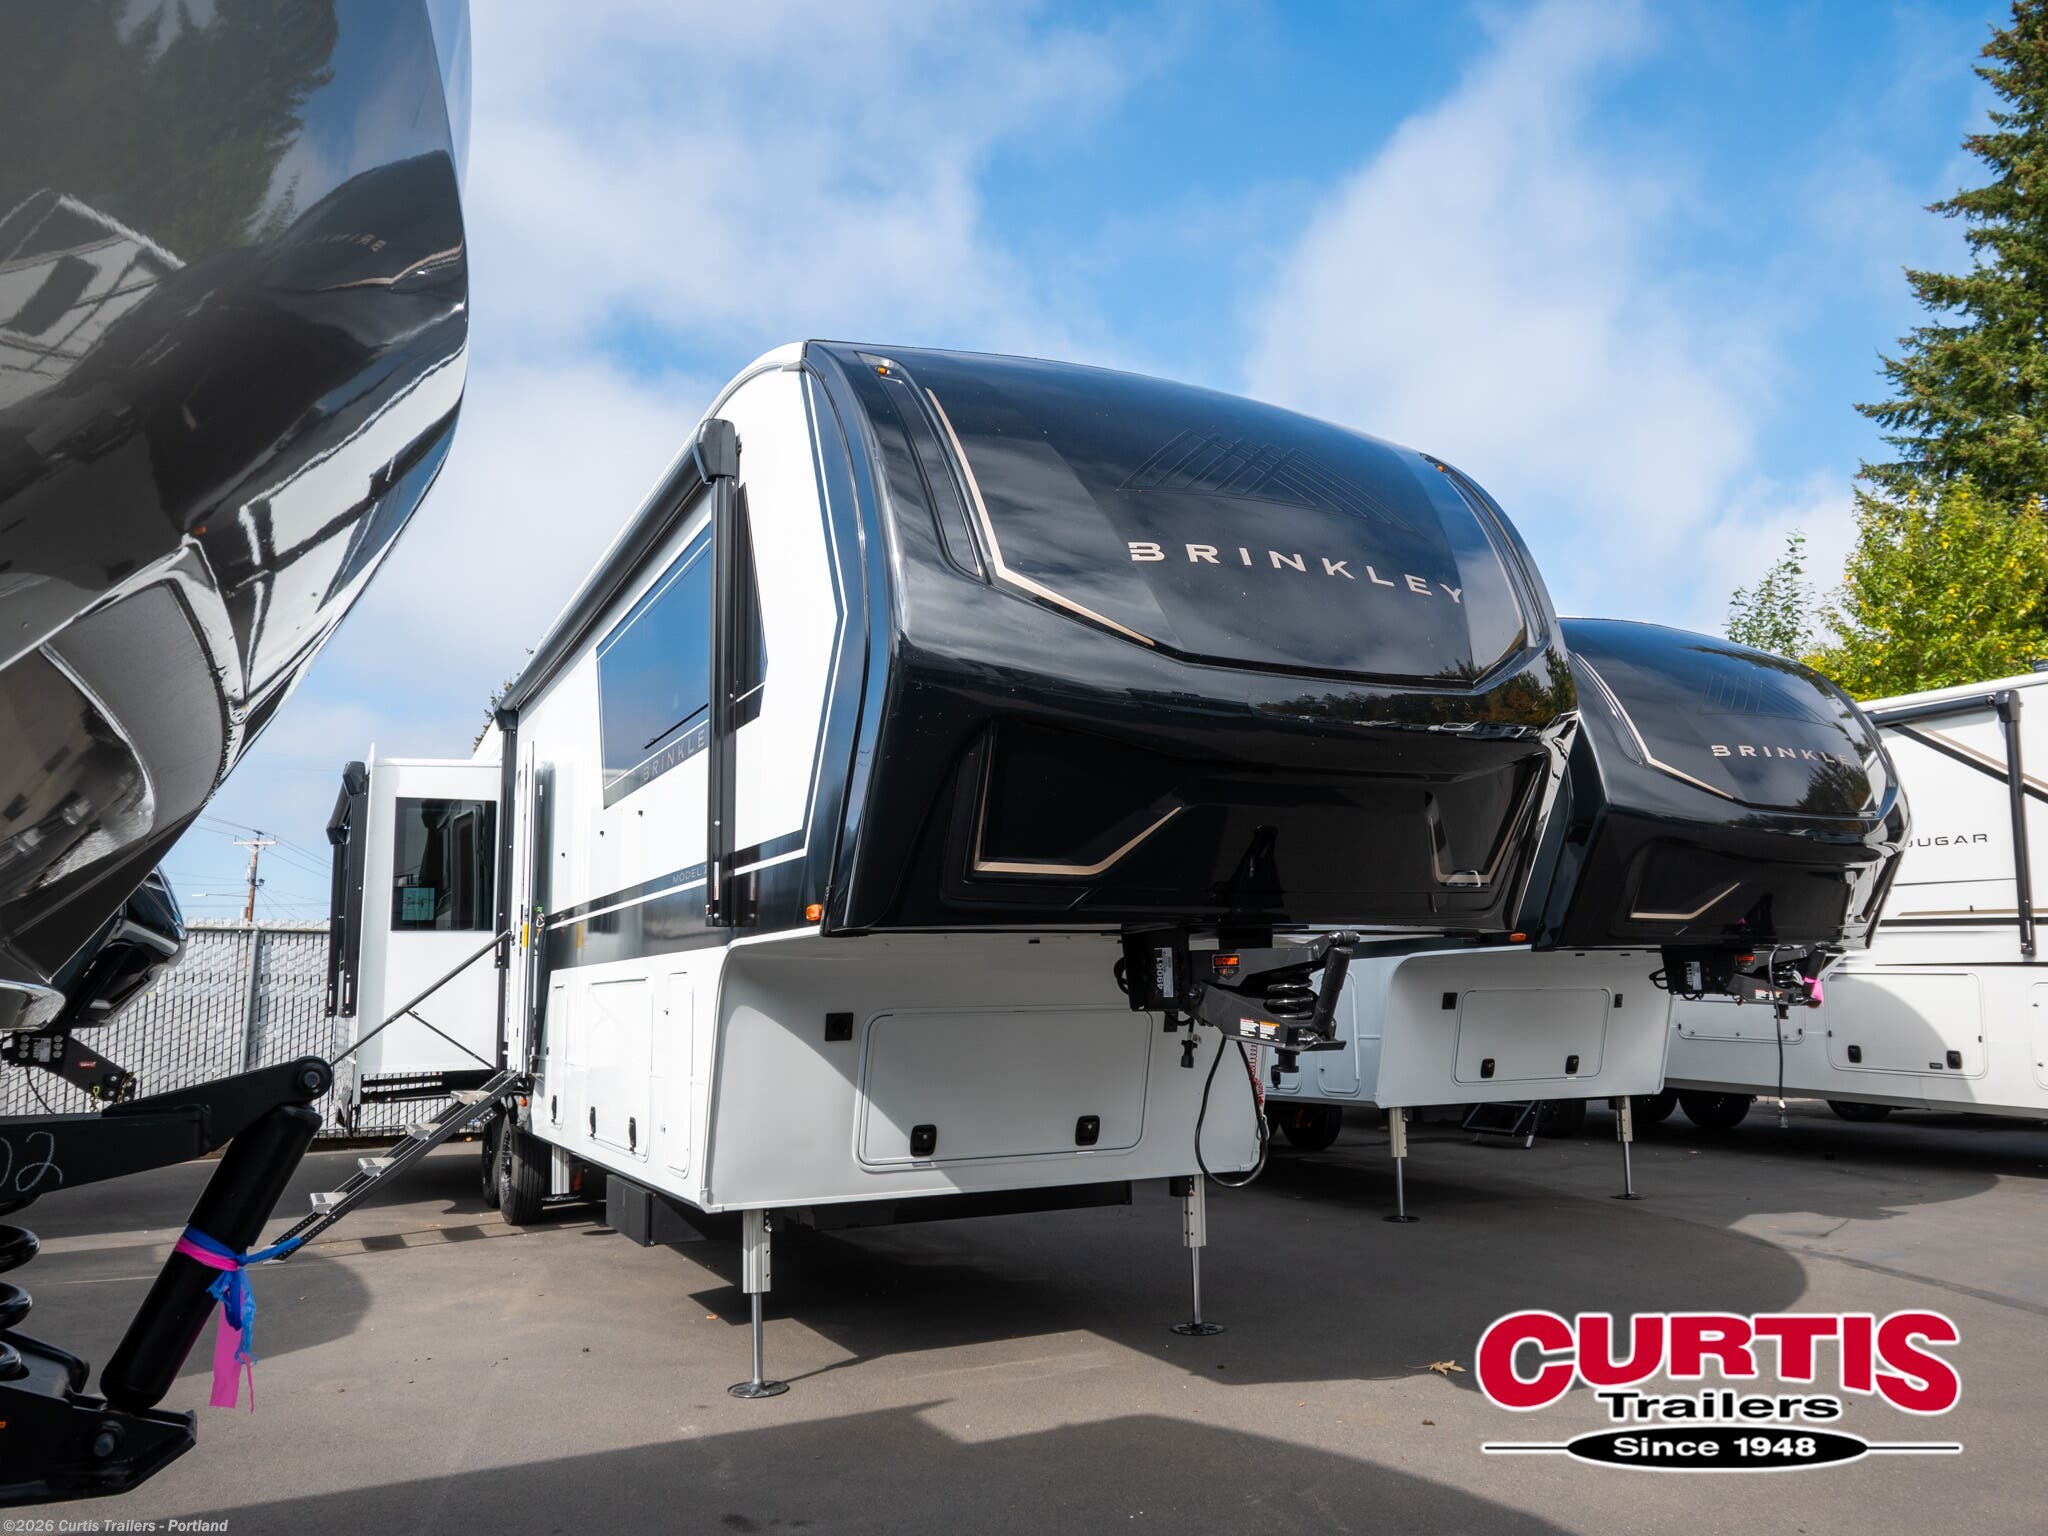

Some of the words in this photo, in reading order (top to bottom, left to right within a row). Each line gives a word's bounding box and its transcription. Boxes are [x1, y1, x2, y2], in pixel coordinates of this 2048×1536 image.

[1127, 542, 1462, 604] BRINKLEY
[643, 729, 706, 781] BRINKLE
[1909, 834, 1988, 848] UGAR
[672, 867, 702, 884] MODEL
